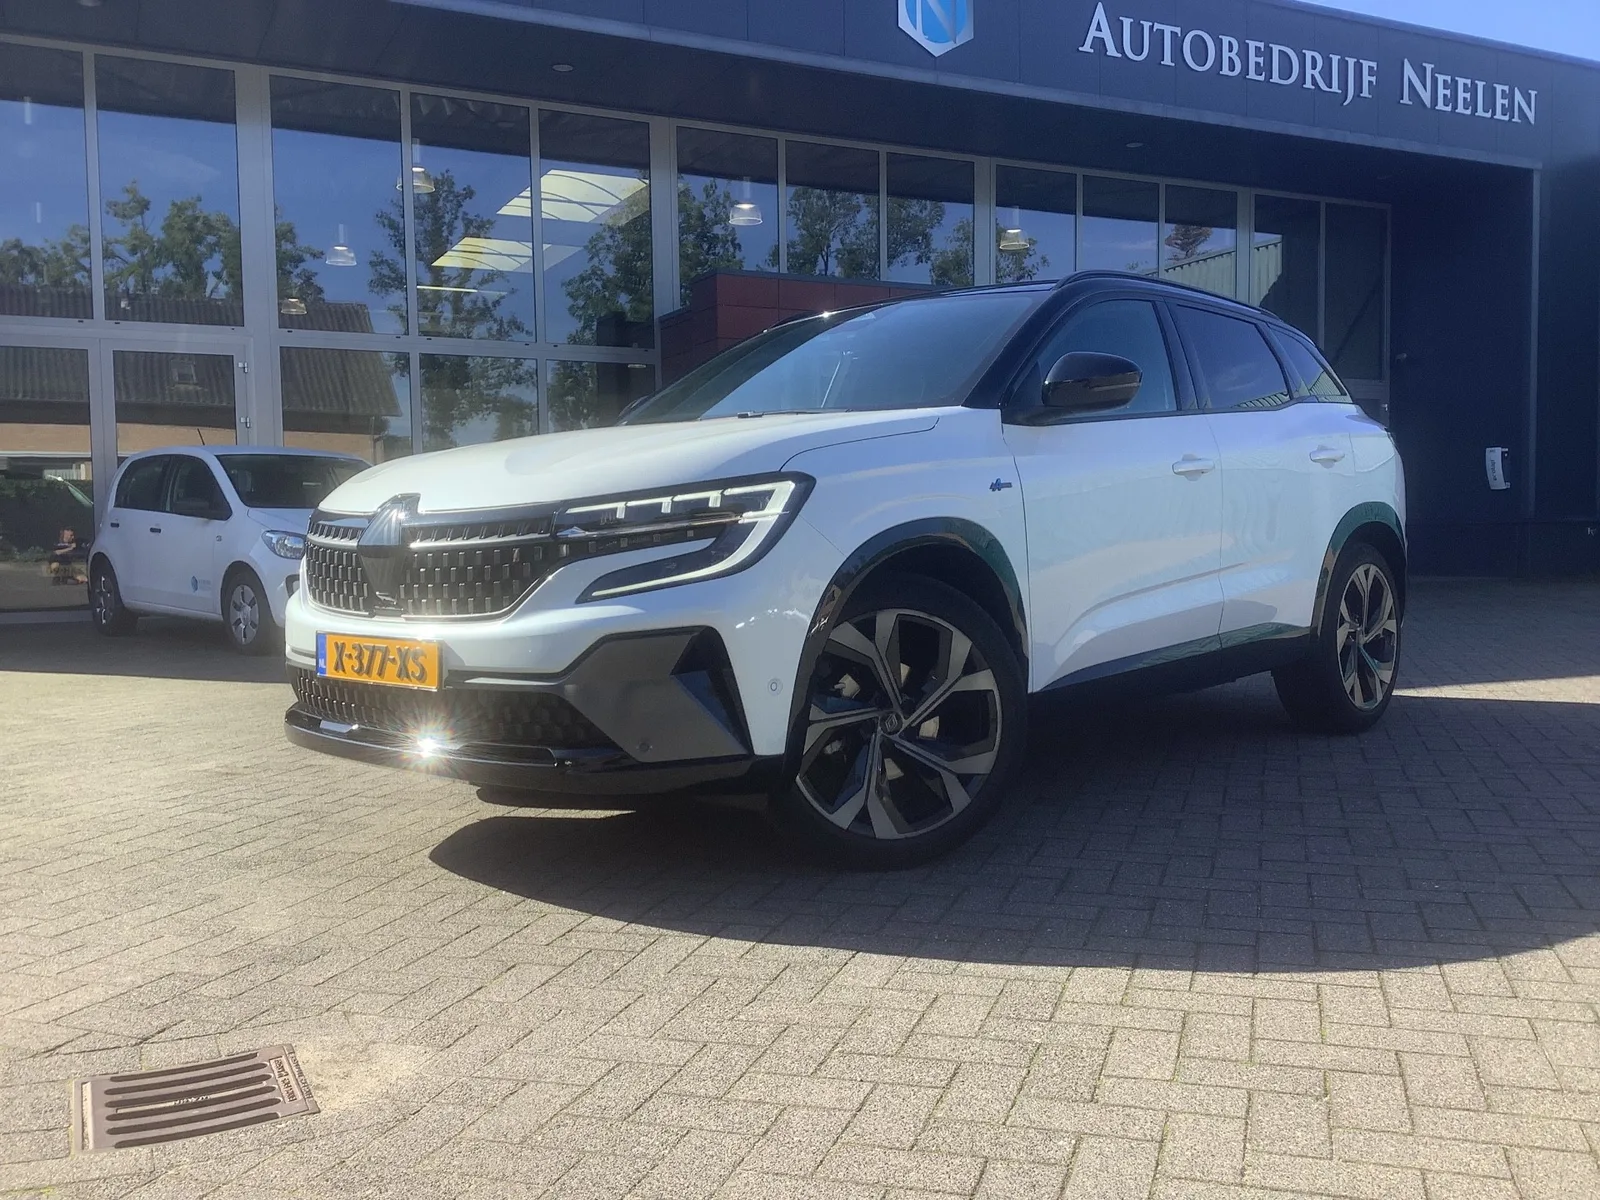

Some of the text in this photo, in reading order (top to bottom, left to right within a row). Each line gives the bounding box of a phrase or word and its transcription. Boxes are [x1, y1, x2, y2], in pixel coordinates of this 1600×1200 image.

[1078, 1, 1538, 125] AUTOBEDRIJF NEELEN
[318, 658, 326, 669] NL
[333, 640, 428, 683] X-377-XS
